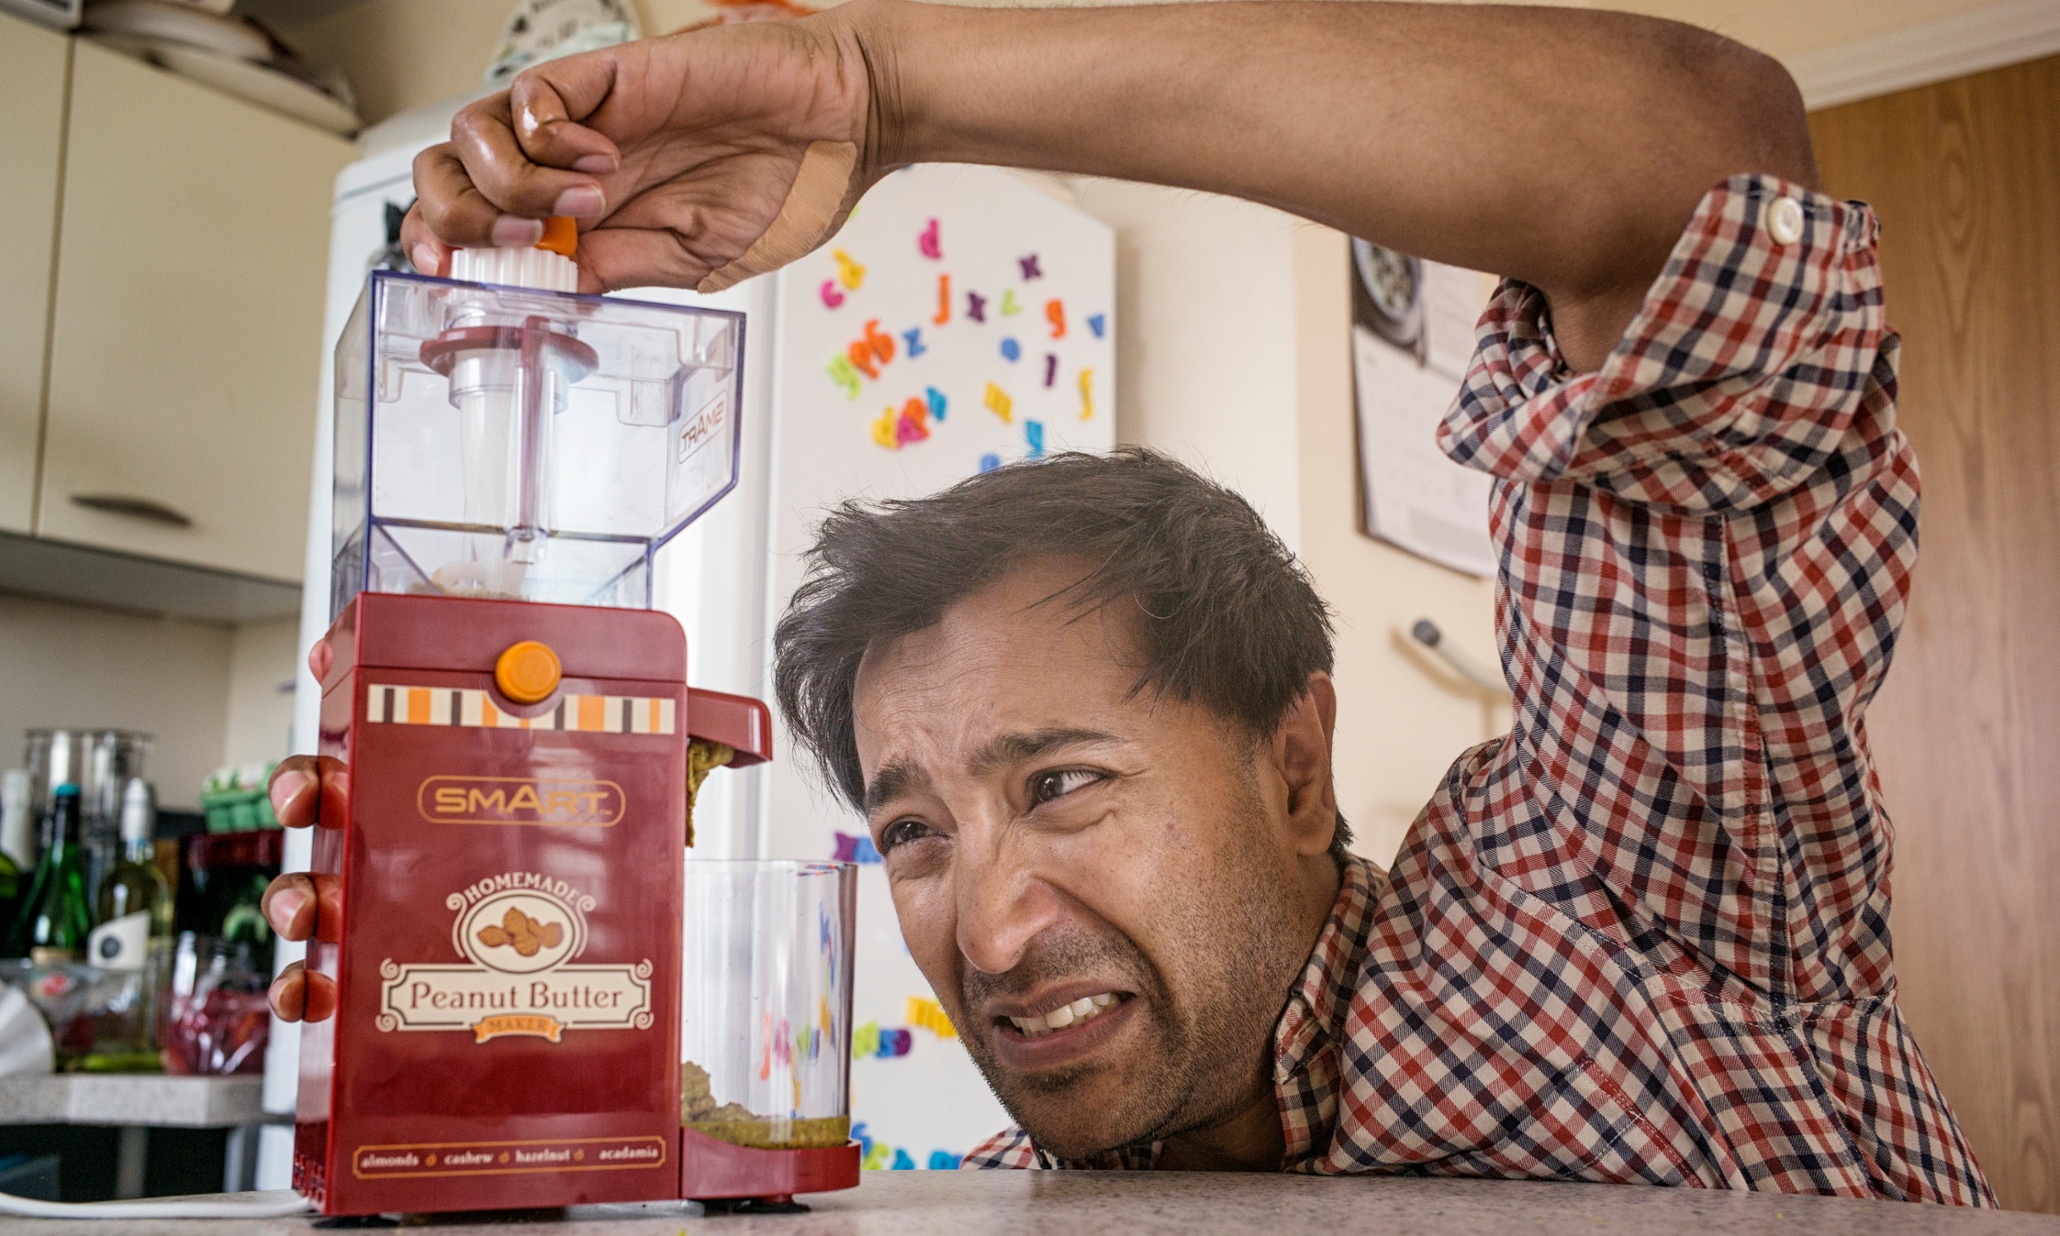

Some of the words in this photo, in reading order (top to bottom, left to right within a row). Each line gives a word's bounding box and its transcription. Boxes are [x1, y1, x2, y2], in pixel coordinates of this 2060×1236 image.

[434, 784, 610, 816] SMART
[462, 871, 582, 905] HOMEMADE
[408, 980, 520, 1011] Peanut
[528, 979, 624, 1010] Butter
[487, 1016, 548, 1032] MAKER
[360, 1153, 420, 1169] almonds
[443, 1150, 495, 1166] cashew
[514, 1148, 571, 1164] hazelnut
